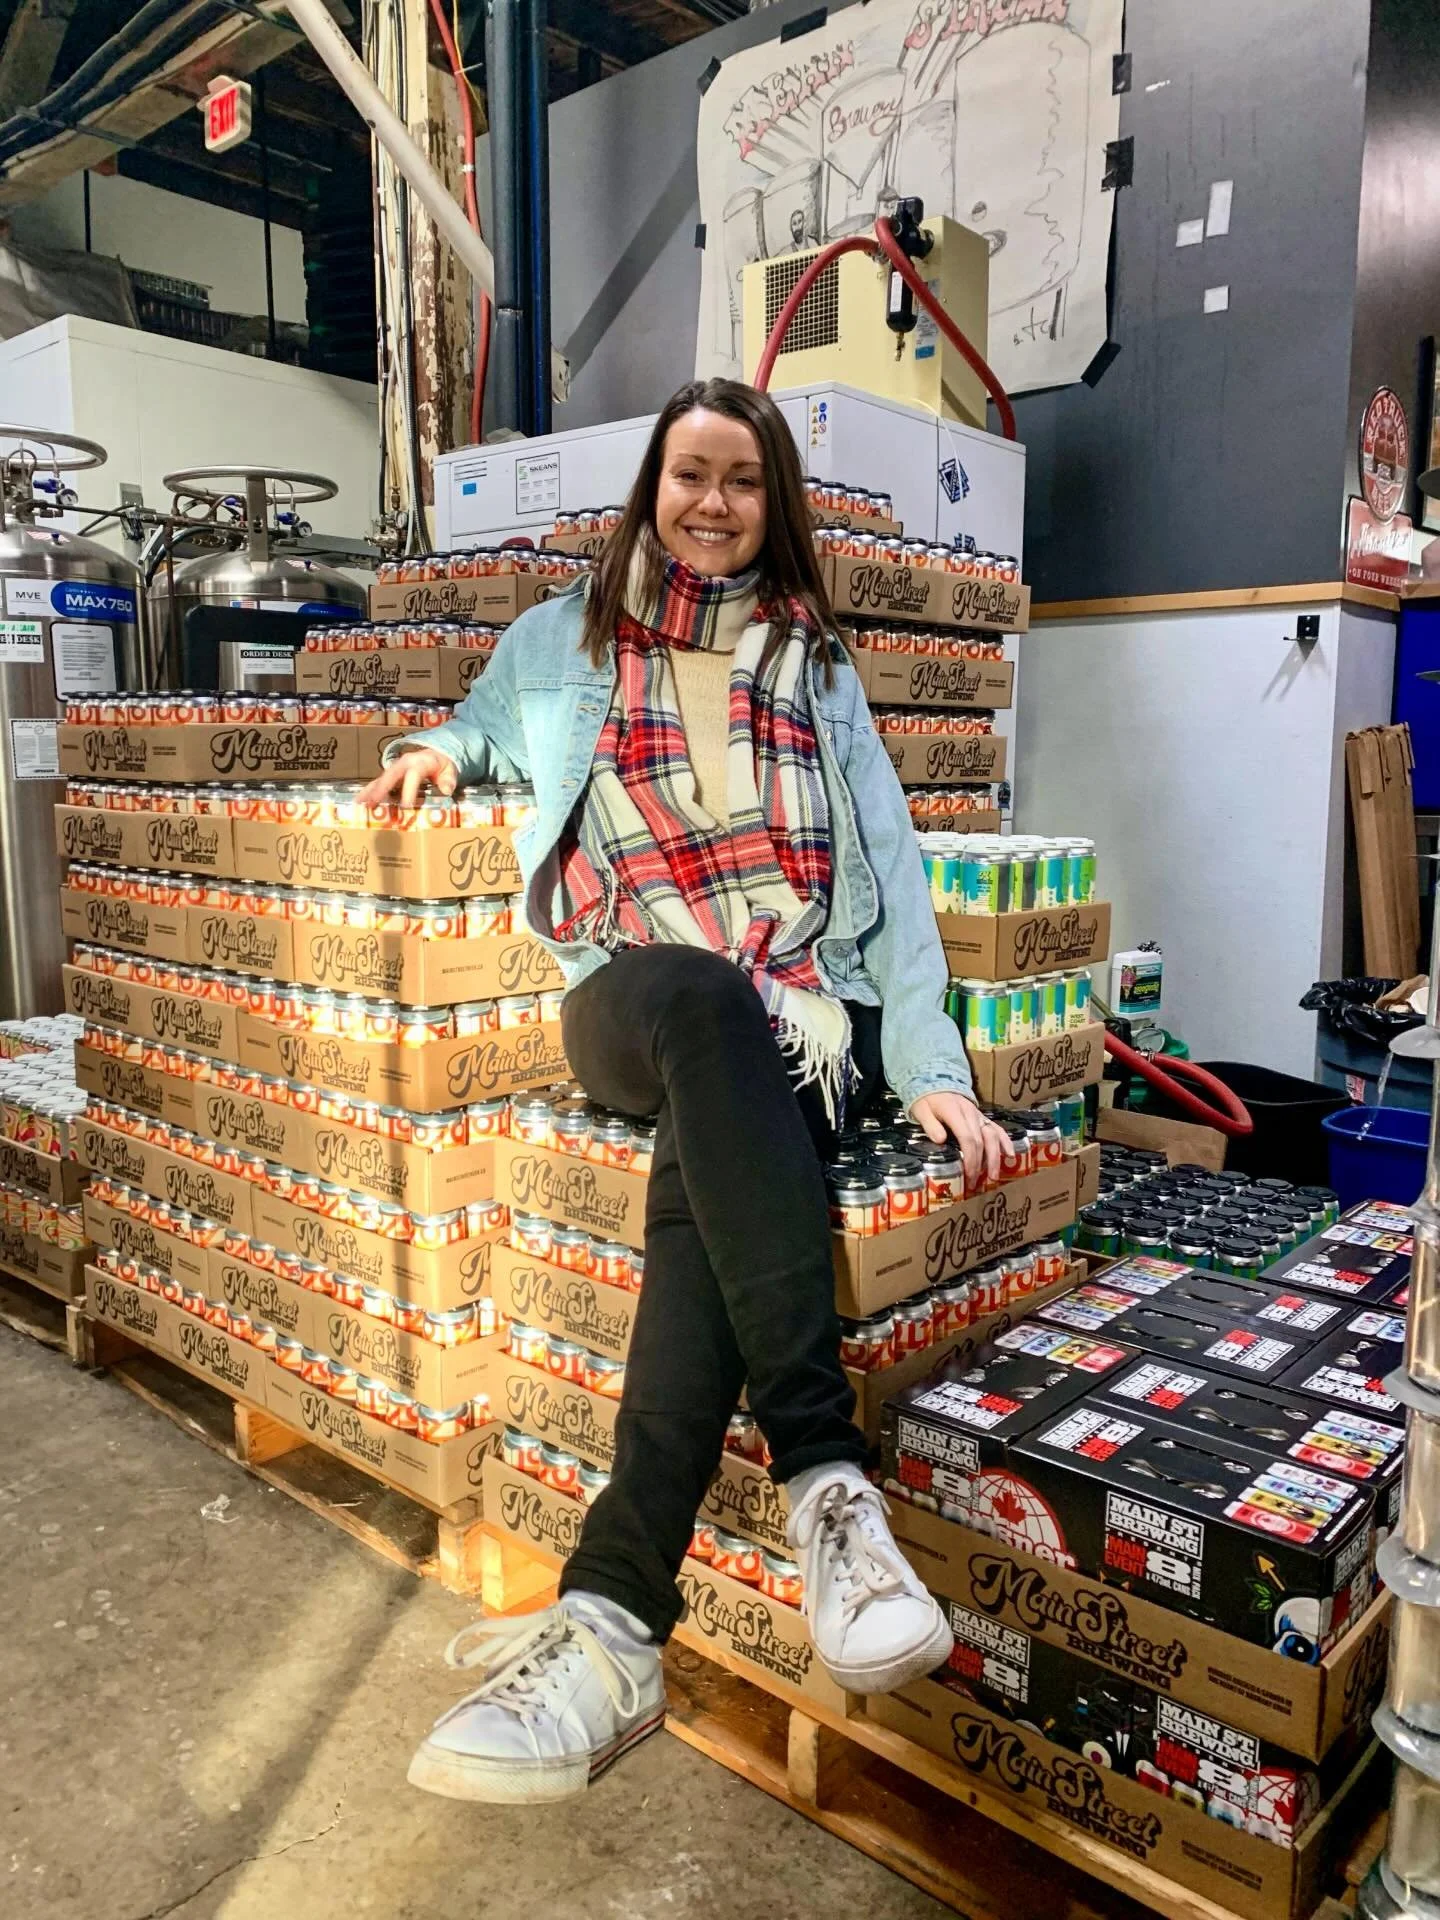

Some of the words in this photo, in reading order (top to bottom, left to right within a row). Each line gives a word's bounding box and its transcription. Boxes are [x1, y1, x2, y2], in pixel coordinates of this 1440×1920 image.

[210, 88, 237, 140] EXIT
[530, 463, 558, 472] SKEANS
[16, 591, 41, 599] MVE
[65, 594, 107, 608] MAX
[108, 598, 132, 612] 750
[17, 636, 41, 644] DESK
[243, 650, 271, 658] ORDER
[274, 761, 330, 771] BREWING
[320, 871, 364, 885] BREWING
[354, 976, 399, 992] BREWING
[322, 1076, 366, 1093] BREWING
[511, 1063, 566, 1084] BREWING
[563, 1206, 620, 1232] BREWING
[977, 1230, 1024, 1260] BREWING
[564, 1320, 620, 1351] BREWING
[901, 1422, 948, 1447] MAIN
[932, 1467, 971, 1499] 8
[1111, 1497, 1169, 1528] MAIN
[1108, 1535, 1147, 1561] MAIN
[1110, 1513, 1199, 1554] BREWING
[1104, 1550, 1145, 1577] EVENT
[1147, 1550, 1191, 1584] 8
[953, 1607, 1000, 1638] MAIN
[953, 1620, 1026, 1662] BREWING
[732, 1638, 802, 1686] BREWING
[983, 1658, 1020, 1689] 8
[1066, 1632, 1172, 1690] BREWING
[1161, 1701, 1220, 1738] MAIN
[1161, 1715, 1254, 1768] BREWING
[1198, 1759, 1248, 1796] 8
